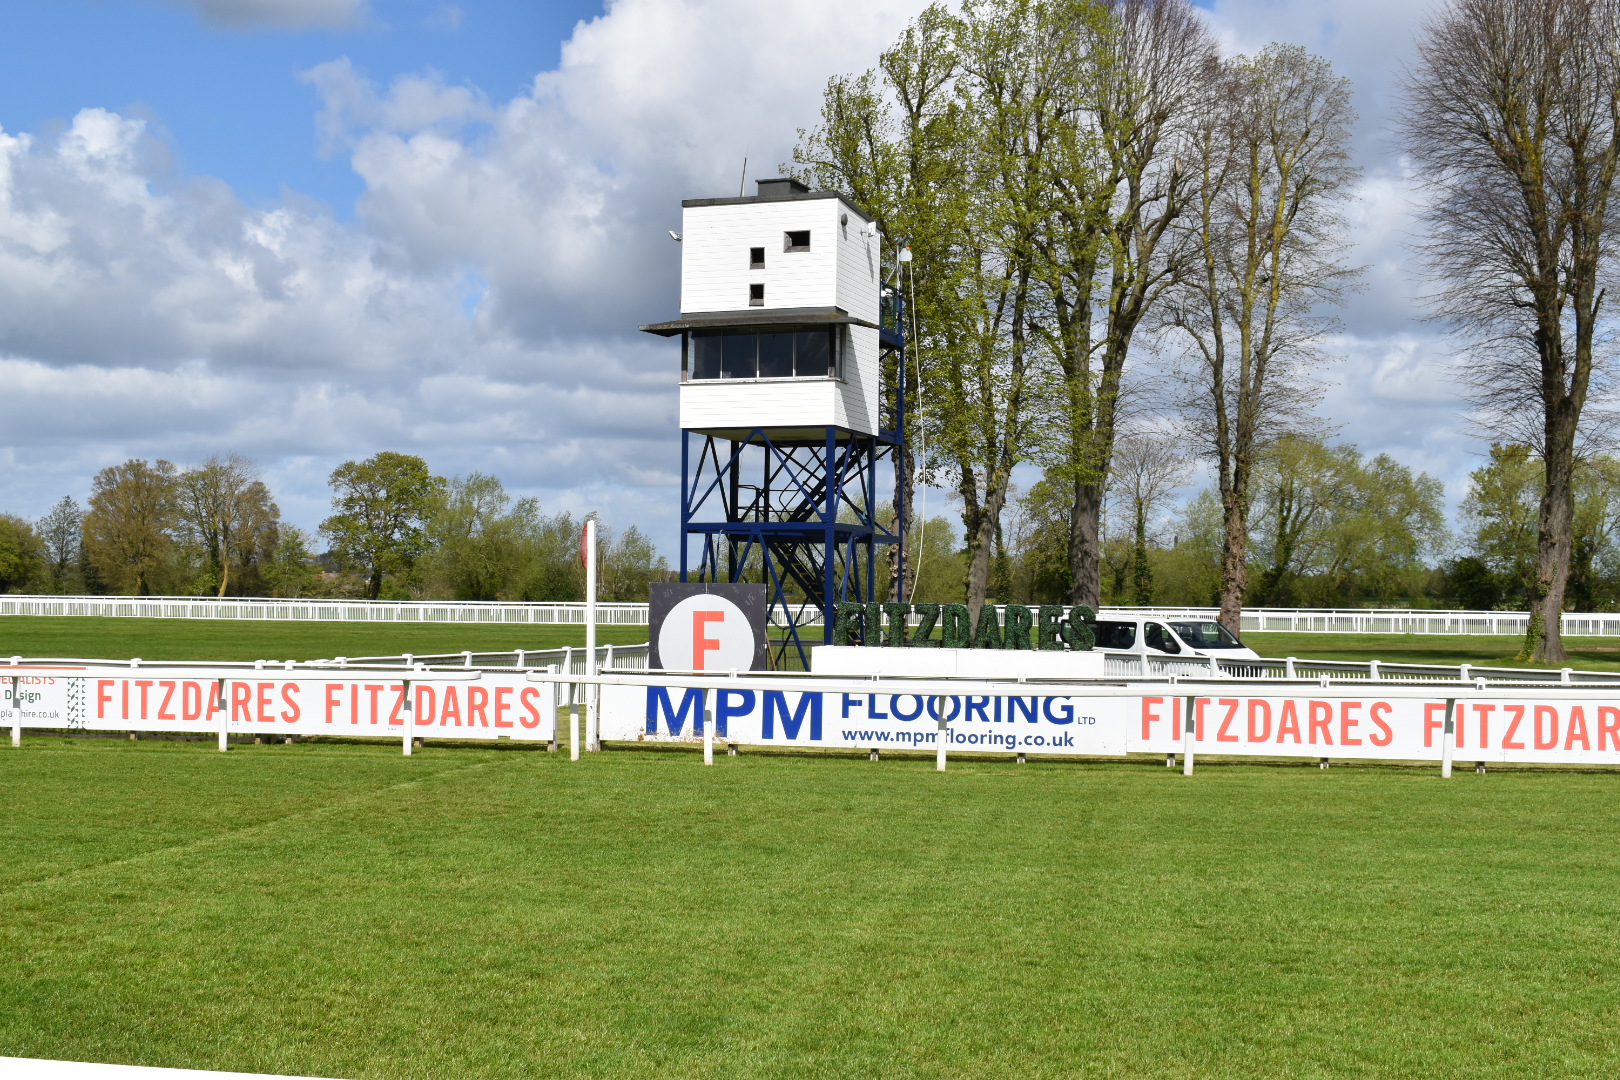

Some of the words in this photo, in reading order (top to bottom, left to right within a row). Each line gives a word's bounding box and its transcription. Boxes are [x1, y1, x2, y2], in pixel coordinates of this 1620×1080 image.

[693, 610, 725, 671] F
[834, 602, 1097, 652] FITZDARES
[0, 709, 59, 720] plahire.co.uk
[5, 690, 41, 703] Dsign
[325, 683, 541, 729] FITZDARES
[645, 685, 823, 741] MPM
[841, 692, 1075, 725] FLOORING
[1077, 716, 1096, 725] LTD
[841, 728, 1075, 750] www.mpmflooring.co.uk
[1141, 696, 1394, 747] FITZDARES
[1423, 702, 1620, 752] FITZDAR
